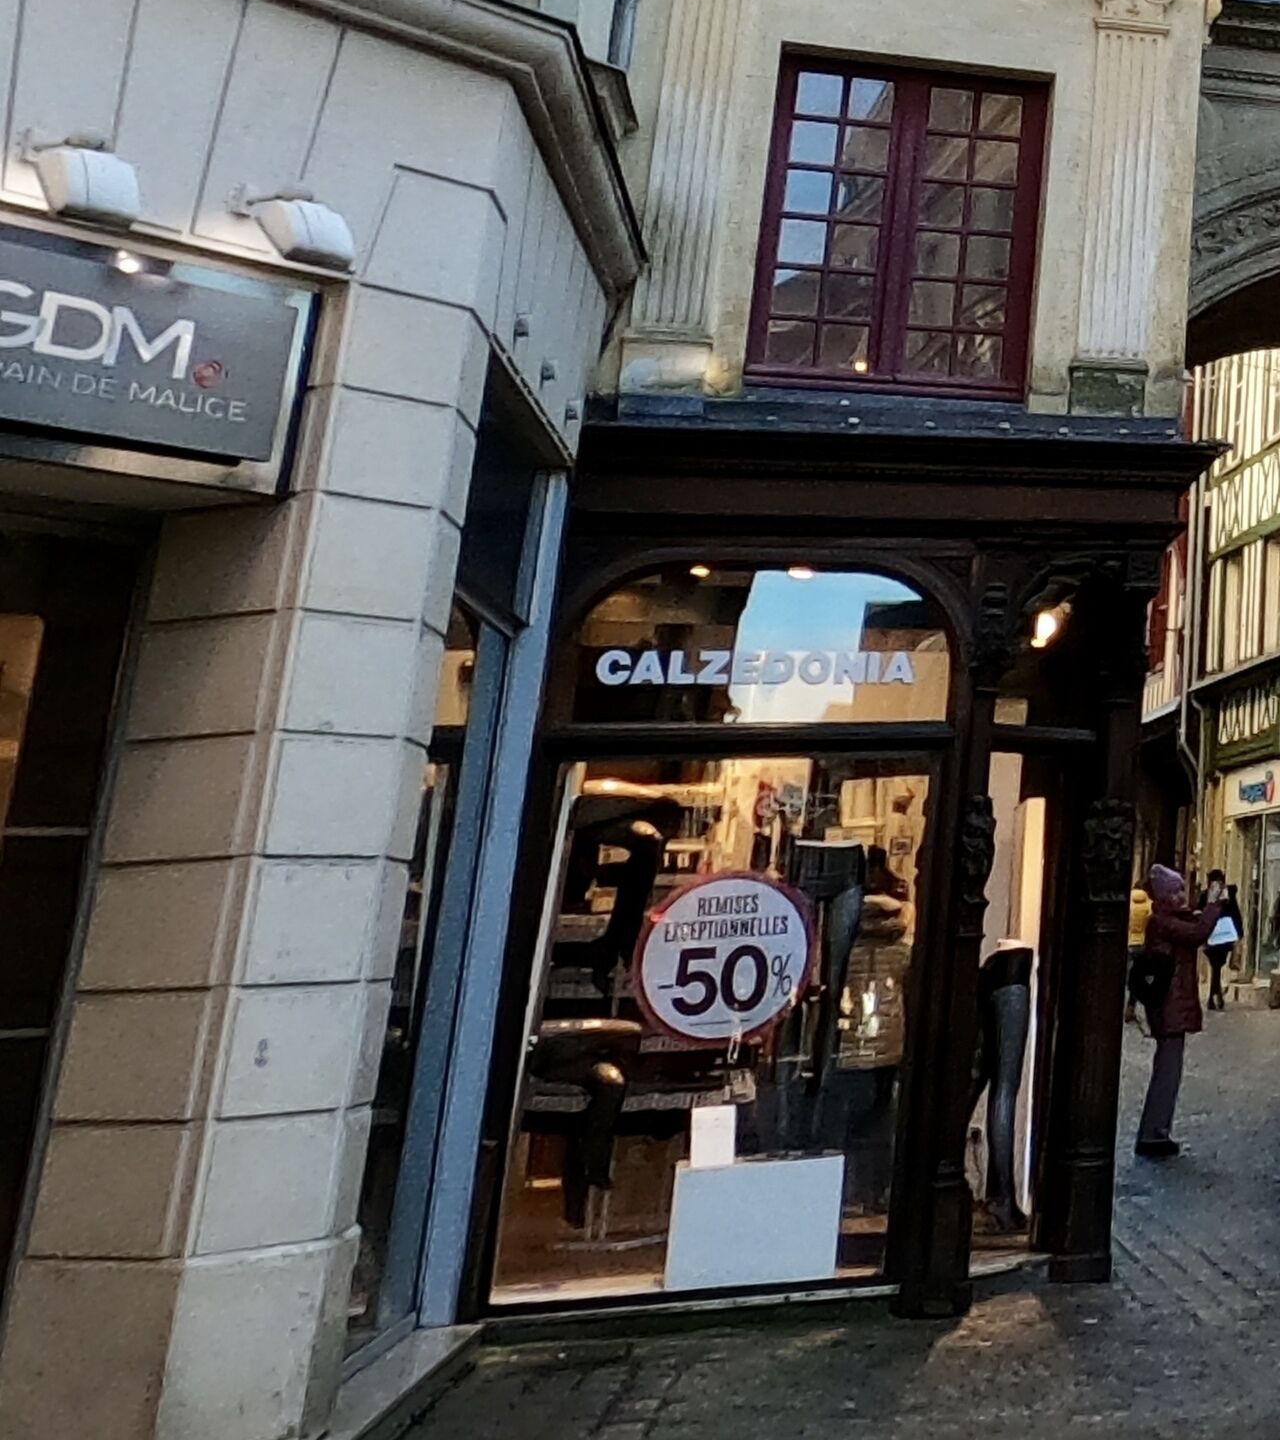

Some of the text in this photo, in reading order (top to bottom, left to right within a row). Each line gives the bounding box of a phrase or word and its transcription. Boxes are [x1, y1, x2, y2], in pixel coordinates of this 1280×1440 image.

[0, 279, 196, 380] GDM
[0, 361, 248, 422] AIN DE MALICE
[595, 649, 916, 686] CALZEDONIA
[697, 893, 760, 917] REMISES
[664, 914, 790, 943] EXCEPTIONNELLES
